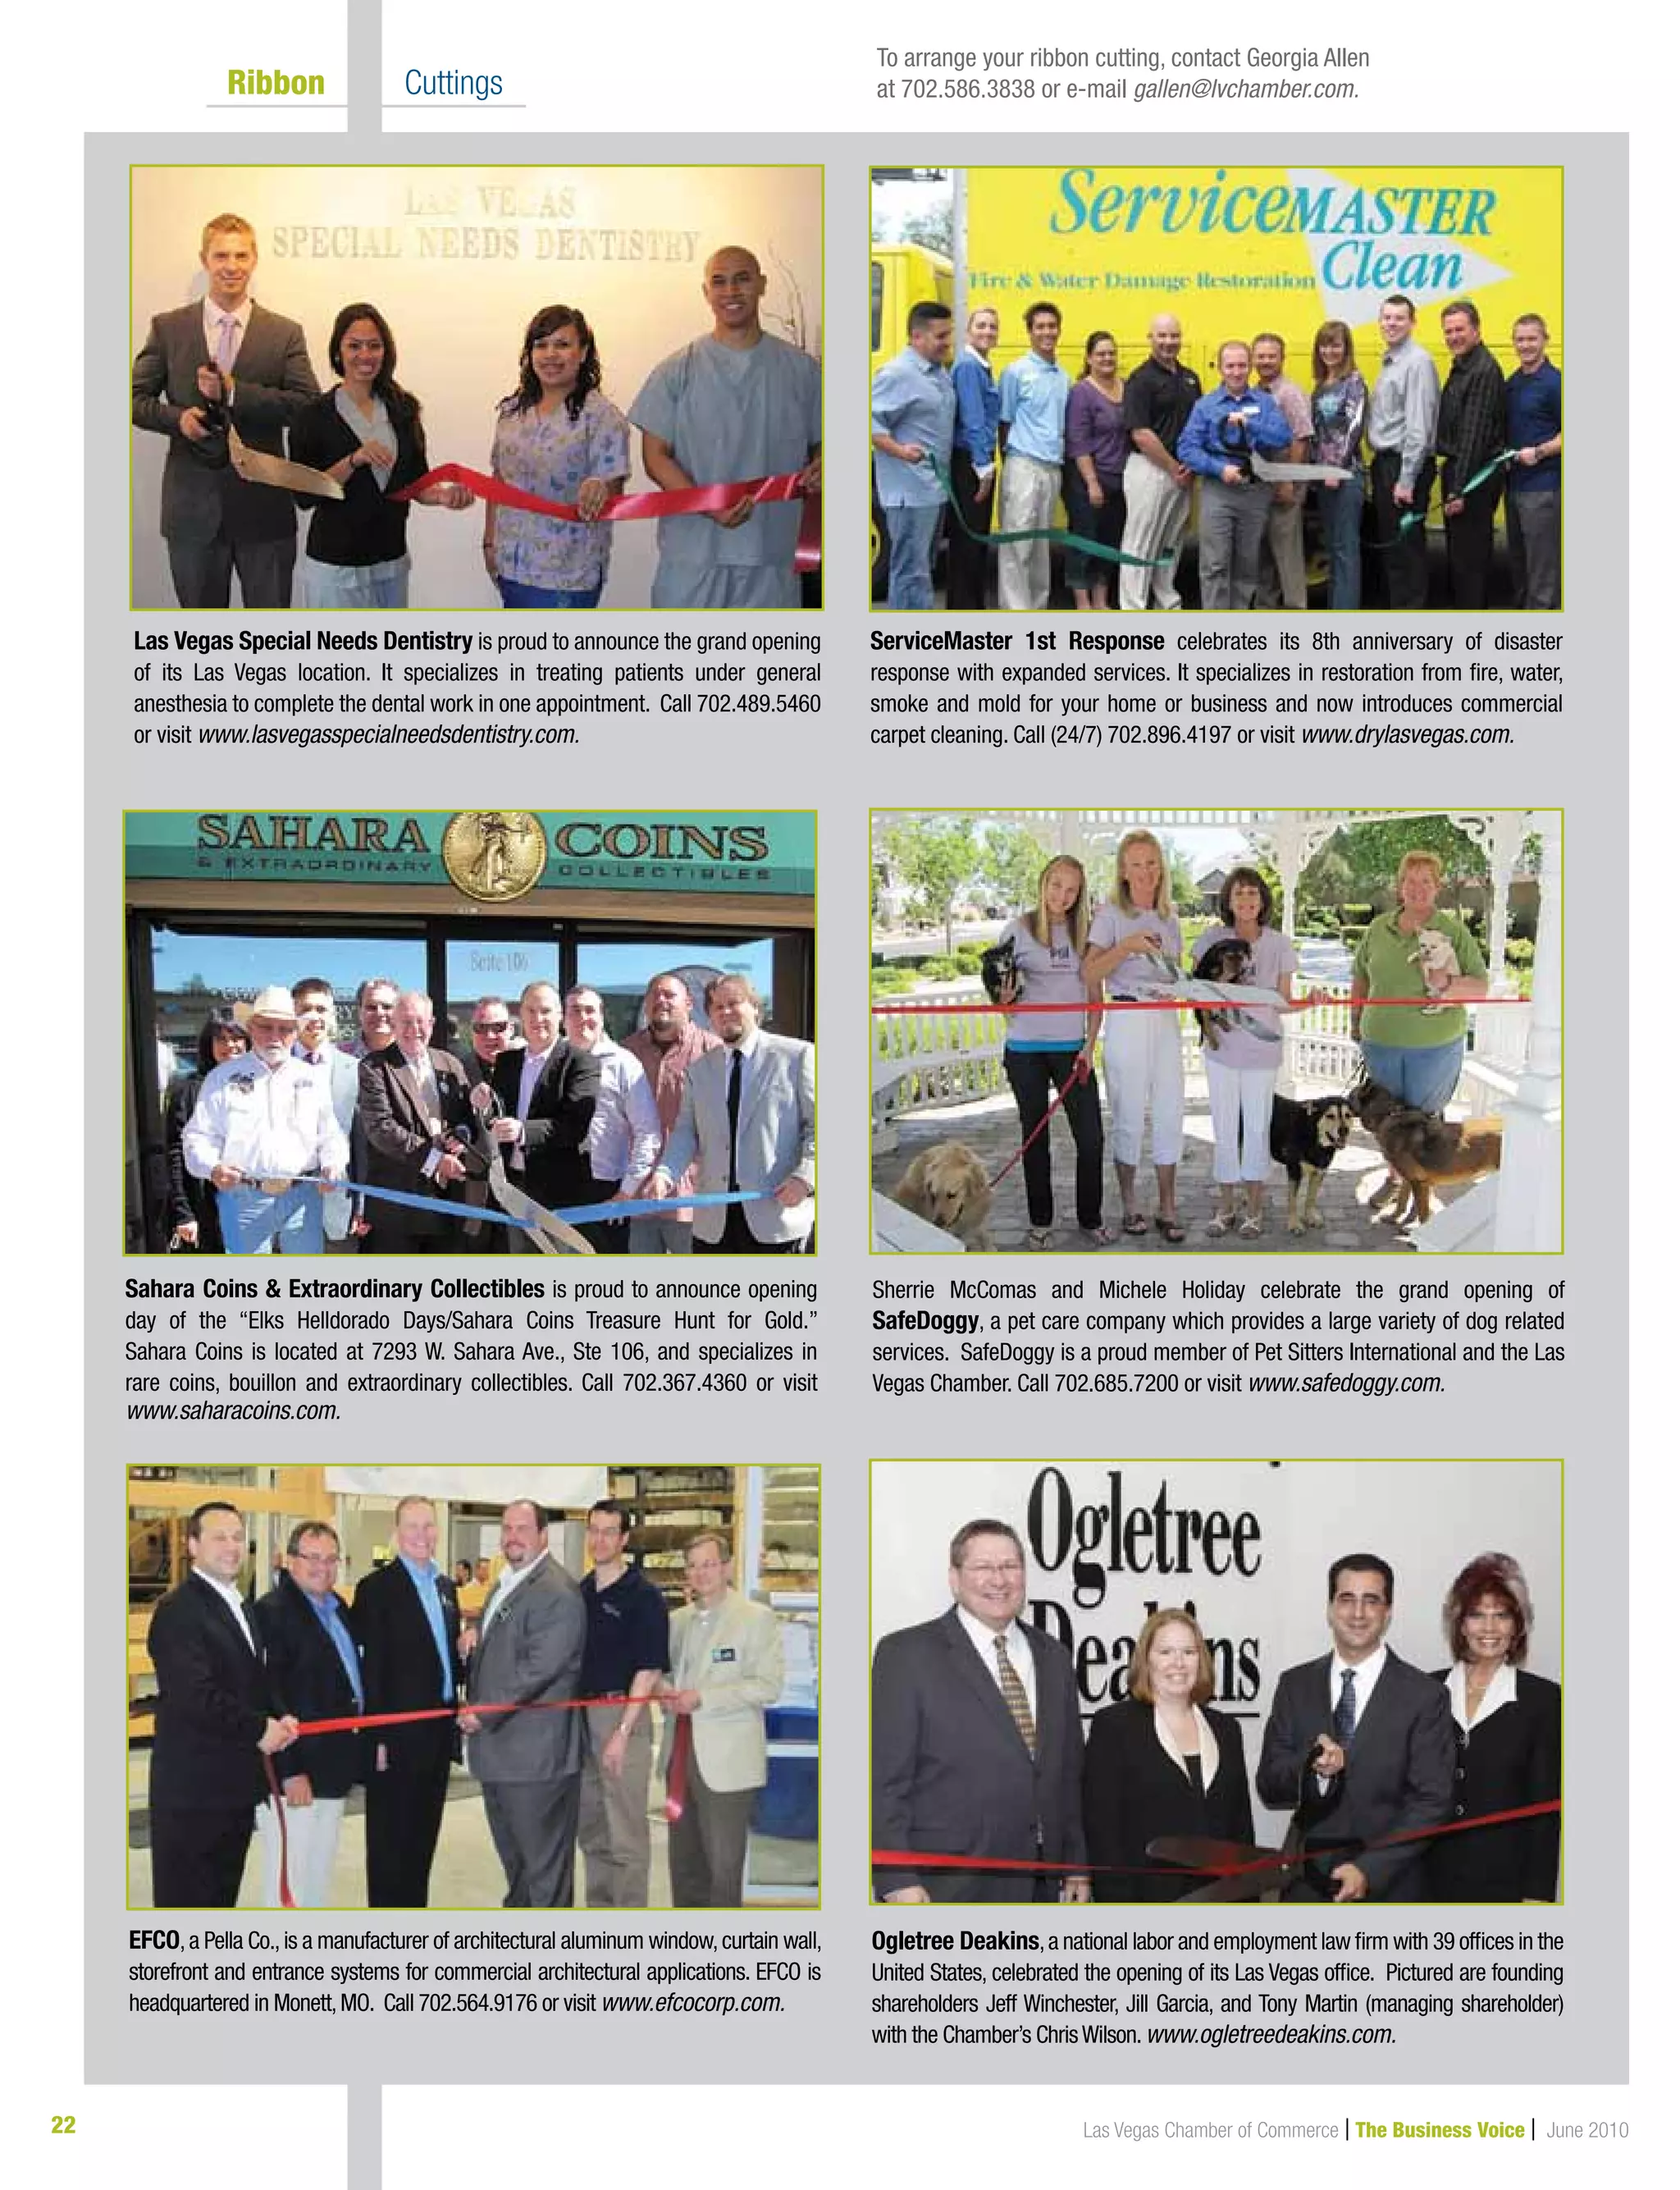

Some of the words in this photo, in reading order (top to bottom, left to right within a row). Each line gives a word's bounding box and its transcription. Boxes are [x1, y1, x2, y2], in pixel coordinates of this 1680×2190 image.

[876, 47, 898, 67] To
[904, 52, 977, 72] arrange
[982, 52, 1025, 71] your
[1030, 47, 1089, 67] ribbon
[1095, 47, 1165, 71] cutting,
[1171, 48, 1241, 67] contact
[1247, 47, 1319, 72] Georgia
[1323, 47, 1369, 67] Allen
[228, 68, 325, 96] Ribbon
[405, 68, 503, 101] Cuttings
[877, 79, 896, 98] at
[901, 79, 1035, 98] 702.586.3838
[1042, 82, 1061, 98] or
[1066, 78, 1126, 98] e-mail
[1133, 78, 1358, 103] gallen@lvchamber.com.
[477, 185, 578, 219] VEAS
[272, 226, 403, 259] SPECIAL
[416, 226, 520, 261] NEEDS
[534, 229, 701, 263] DENTISTRY
[1322, 239, 1463, 290] Clean
[968, 271, 1012, 290] Fire
[1015, 272, 1034, 290] &
[1039, 271, 1099, 290] Water
[1104, 271, 1192, 294] Damage
[1196, 271, 1317, 290] Restoration
[135, 630, 169, 651] Las
[173, 630, 234, 655] Vegas
[239, 630, 311, 655] Special
[317, 630, 378, 651] Needs
[384, 630, 473, 655] Dentistry
[478, 631, 493, 651] is
[498, 631, 547, 655] proud
[551, 632, 569, 651] to
[573, 635, 660, 651] announce
[664, 631, 692, 651] the
[696, 631, 746, 655] grand
[751, 631, 821, 655] opening
[870, 630, 1013, 651] ServiceMaster
[1025, 630, 1057, 651] 1st
[1069, 630, 1166, 655] Response
[1176, 631, 1267, 651] celebrates
[1280, 631, 1300, 651] its
[1312, 631, 1340, 651] 8th
[1352, 631, 1454, 655] anniversary
[1465, 631, 1483, 651] of
[1494, 631, 1564, 651] disaster
[134, 729, 153, 744] or
[156, 725, 192, 744] visit
[199, 724, 579, 748] www.lasvegasspecialneedsdentistry.com.
[870, 725, 926, 748] carpet
[930, 725, 1008, 748] cleaning.
[1013, 725, 1045, 744] Call
[1051, 725, 1102, 748] (24/7)
[1107, 725, 1232, 744] 702.896.4197
[1237, 729, 1256, 744] or
[1259, 725, 1295, 744] visit
[1302, 724, 1514, 748] www.drylasvegas.com.
[197, 812, 431, 854] SAHARA
[555, 821, 769, 862] COINS
[224, 856, 432, 873] EXTRAORDINARY
[558, 864, 772, 881] COLLECTIBLES
[125, 1278, 195, 1299] Sahara
[203, 1278, 258, 1299] Coins
[265, 1278, 281, 1299] &
[289, 1278, 423, 1303] Extraordinary
[431, 1278, 546, 1299] Collectibles
[553, 1279, 567, 1299] is
[574, 1279, 624, 1302] proud
[631, 1279, 649, 1299] to
[655, 1283, 741, 1299] announce
[748, 1279, 817, 1303] opening
[872, 1279, 935, 1299] Sherrie
[950, 1279, 1037, 1299] McComas
[1051, 1280, 1084, 1299] and
[1099, 1280, 1167, 1299] Michele
[1182, 1280, 1246, 1303] Holiday
[1260, 1280, 1341, 1299] celebrate
[1355, 1280, 1384, 1299] the
[1399, 1280, 1449, 1303] grand
[1463, 1280, 1533, 1303] opening
[1548, 1279, 1566, 1299] of
[872, 1373, 925, 1397] Vegas
[930, 1373, 1011, 1392] Chamber.
[1017, 1373, 1048, 1392] Call
[1054, 1374, 1179, 1392] 702.685.7200
[1184, 1377, 1203, 1392] or
[1207, 1373, 1243, 1392] visit
[1249, 1372, 1445, 1397] www.safedoggy.com.
[127, 1400, 340, 1420] www.saharacoins.com.
[1027, 1466, 1262, 1608] Ogletree
[129, 1929, 185, 1953] EFCO,
[189, 1934, 200, 1950] a
[204, 1930, 244, 1950] Pella
[248, 1930, 280, 1953] Co.,
[284, 1931, 298, 1950] is
[302, 1935, 313, 1950] a
[317, 1930, 430, 1950] manufacturer
[433, 1930, 450, 1950] of
[454, 1930, 556, 1950] architectural
[560, 1931, 644, 1950] aluminum
[648, 1931, 718, 1953] window,
[722, 1931, 778, 1950] curtain
[783, 1931, 821, 1953] wall,
[871, 1930, 955, 1955] Ogletree
[960, 1930, 1044, 1954] Deakins,
[1048, 1935, 1059, 1950] a
[1063, 1932, 1128, 1950] national
[1133, 1932, 1175, 1950] labor
[1177, 1932, 1209, 1950] and
[1213, 1932, 1318, 1955] employment
[1322, 1931, 1352, 1950] law
[1354, 1931, 1389, 1950] firm
[1392, 1932, 1428, 1950] with
[1433, 1932, 1455, 1950] 39
[1459, 1931, 1514, 1950] offices
[1518, 1932, 1533, 1950] in
[1536, 1931, 1564, 1950] the
[129, 1992, 249, 2016] headquartered
[254, 1992, 269, 2012] in
[274, 1992, 336, 2015] Monett,
[340, 1992, 374, 2012] MO.
[384, 1992, 414, 2012] Call
[418, 1993, 538, 2012] 702.564.9176
[541, 1996, 560, 2012] or
[563, 1992, 597, 2012] visit
[603, 1991, 785, 2016] www.efcocorp.com.
[871, 2024, 907, 2044] with
[911, 2024, 938, 2044] the
[943, 2024, 1032, 2044] Chamber’s
[1036, 2024, 1079, 2044] Chris
[1081, 2024, 1141, 2044] Wilson.
[1148, 2023, 1396, 2048] www.ogletreedeakins.com.
[51, 2115, 76, 2134] 22
[1084, 2121, 1110, 2138] Las
[1114, 2121, 1159, 2142] Vegas
[1165, 2121, 1234, 2138] Chamber
[1238, 2121, 1253, 2138] of
[1258, 2121, 1339, 2138] Commerce
[1354, 2121, 1388, 2138] The
[1392, 2121, 1472, 2139] Business
[1477, 2121, 1526, 2139] Voice
[1546, 2121, 1583, 2138] June
[1589, 2121, 1629, 2138] 2010
